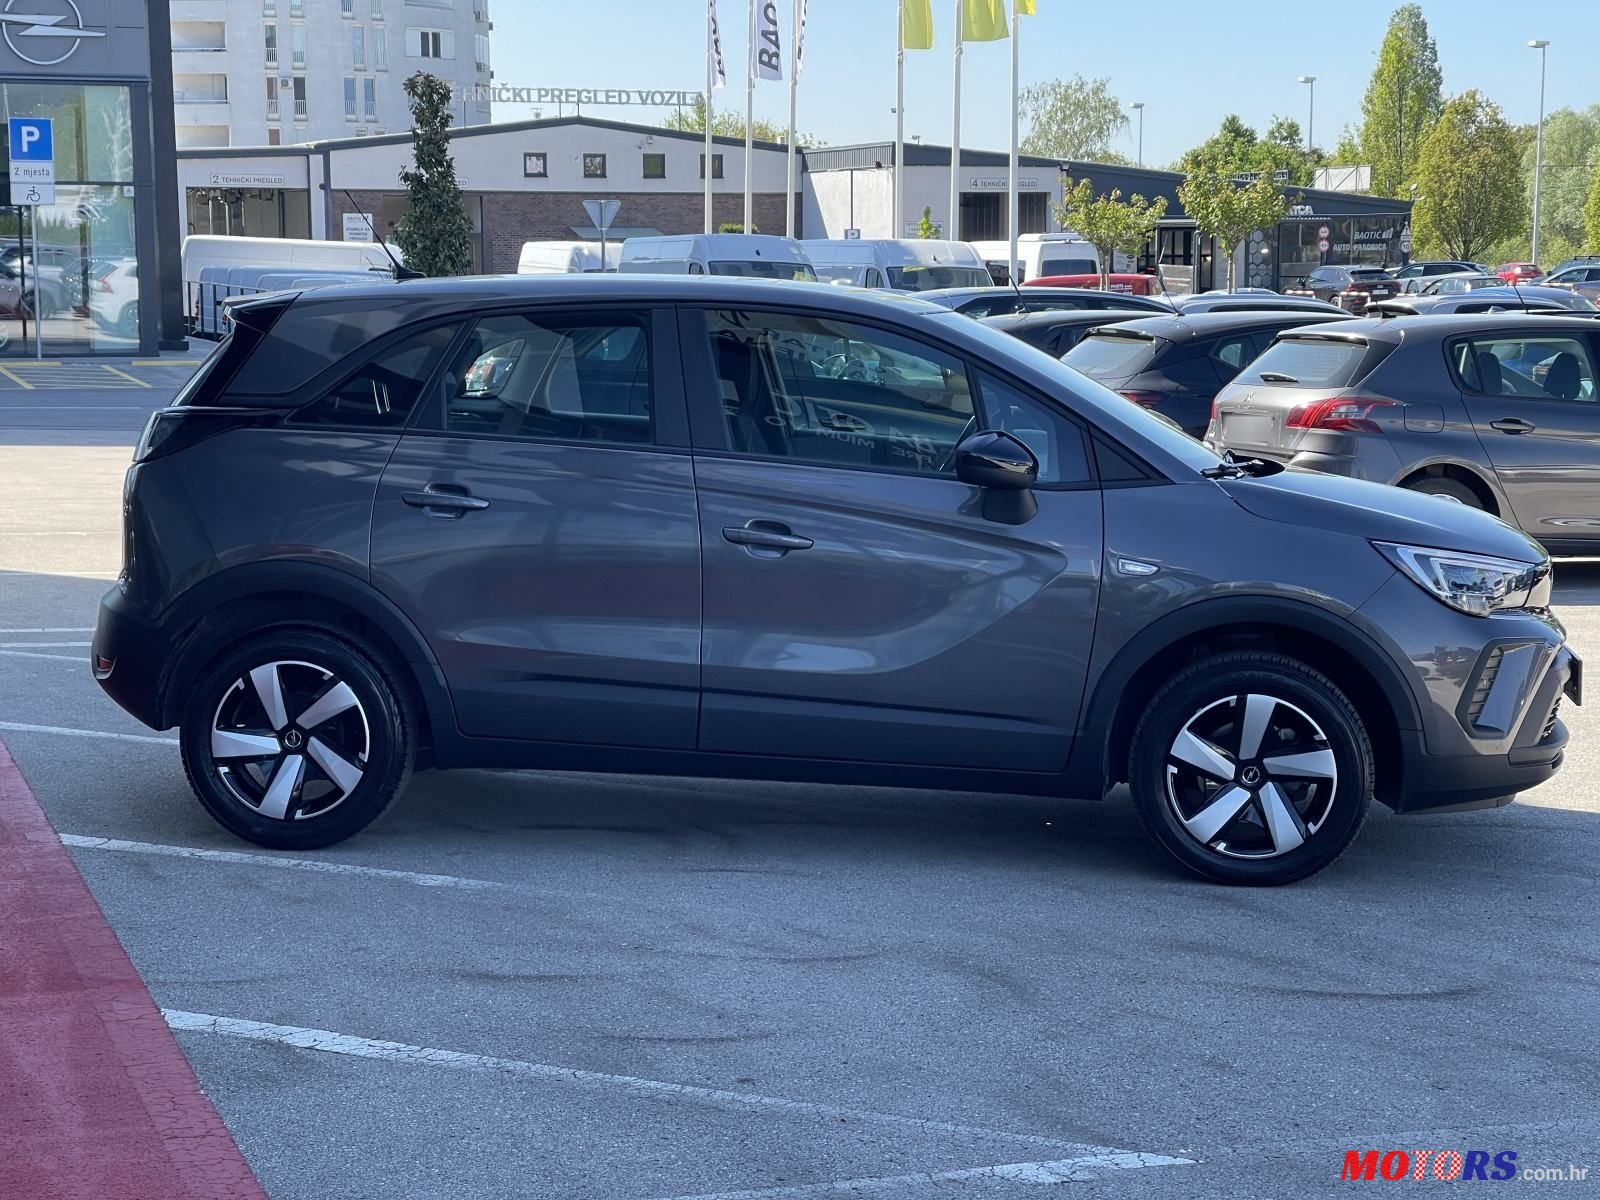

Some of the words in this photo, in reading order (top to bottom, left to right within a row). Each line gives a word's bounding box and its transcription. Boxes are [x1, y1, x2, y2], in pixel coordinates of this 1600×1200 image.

[453, 83, 531, 102] EHNIČKI
[537, 88, 630, 105] PREGLED
[638, 90, 706, 107] VOZILA
[21, 125, 40, 153] P
[14, 167, 20, 176] 2
[23, 168, 50, 177] mjesta
[212, 175, 219, 184] 2
[221, 176, 252, 184] TEHNIČKI
[972, 179, 978, 187] 4
[1354, 230, 1383, 240] BAOTIĆ
[1333, 243, 1351, 251] AUTO
